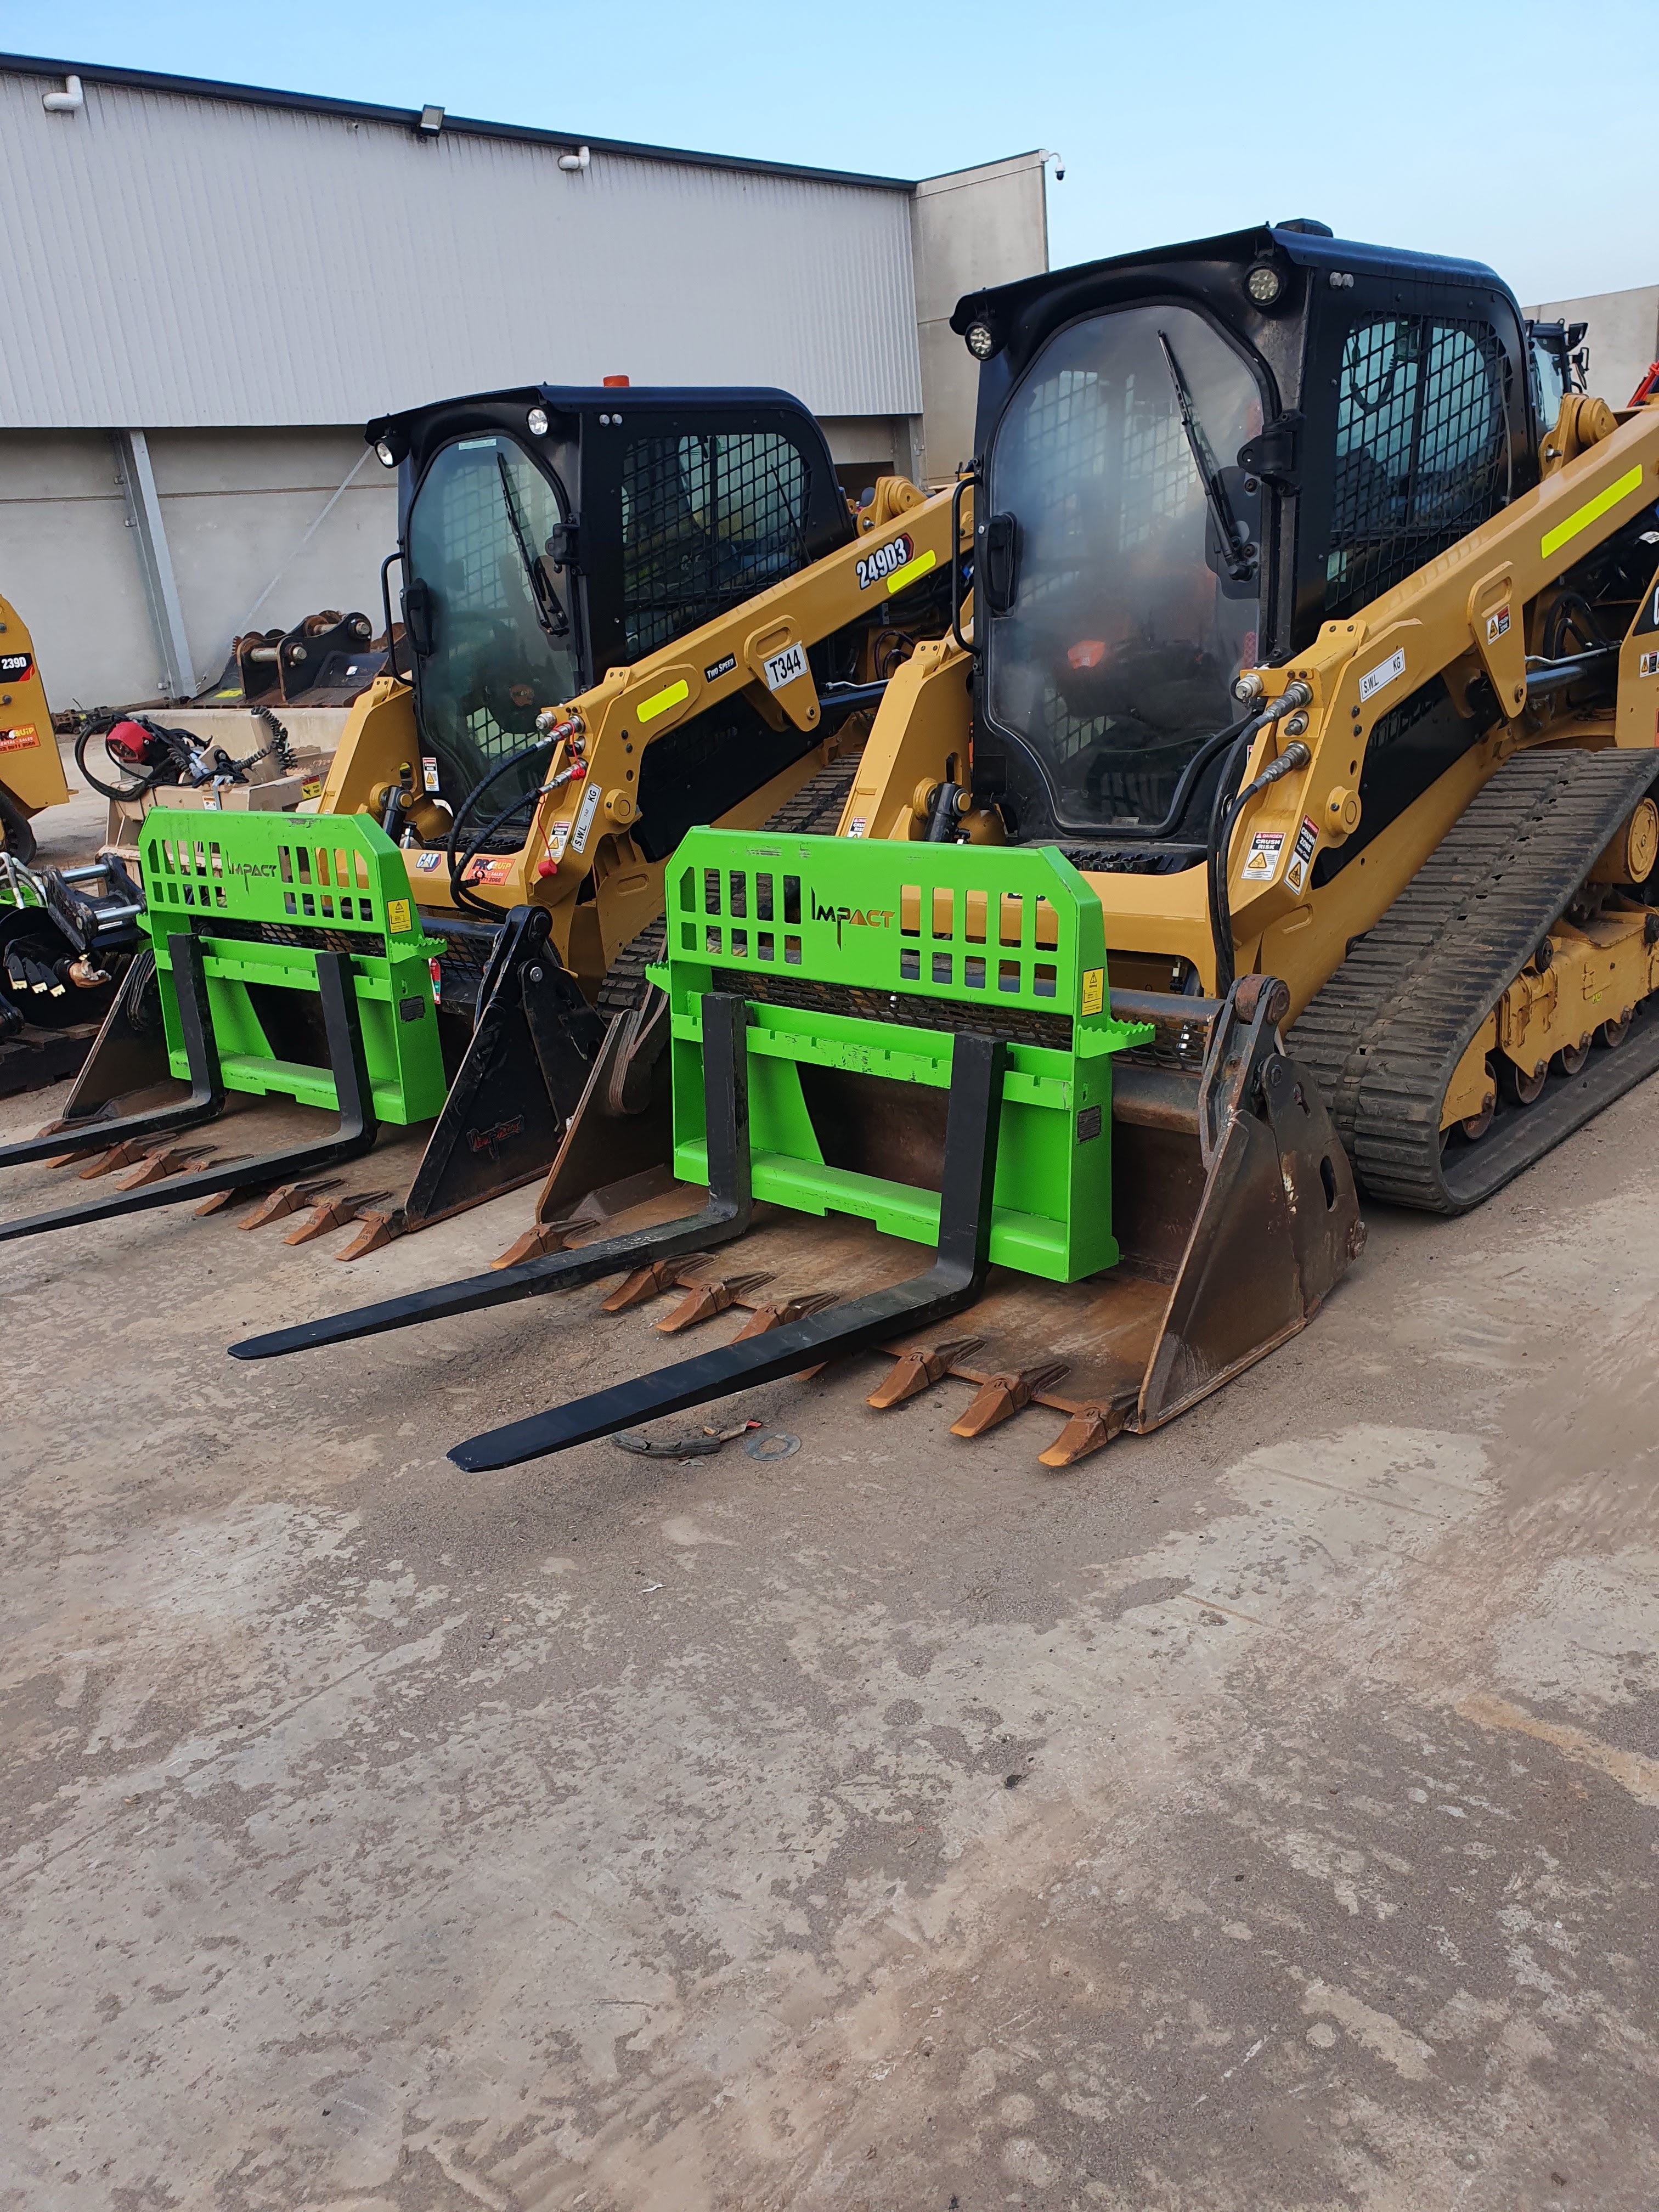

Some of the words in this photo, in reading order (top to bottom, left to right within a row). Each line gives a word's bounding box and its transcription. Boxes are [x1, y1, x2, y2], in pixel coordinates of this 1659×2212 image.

[856, 538, 907, 589] 249D3
[1, 656, 27, 669] 239D
[719, 658, 734, 673] SPEED
[769, 649, 802, 683] T344
[1392, 656, 1401, 672] KG
[0, 727, 34, 741] ROQUiP
[574, 825, 588, 847] S.W.L.
[588, 789, 597, 803] KG
[1299, 836, 1312, 853] ZONE
[1301, 827, 1316, 845] CRUSH
[416, 853, 439, 868] CAT
[810, 886, 896, 952] IMPACT
